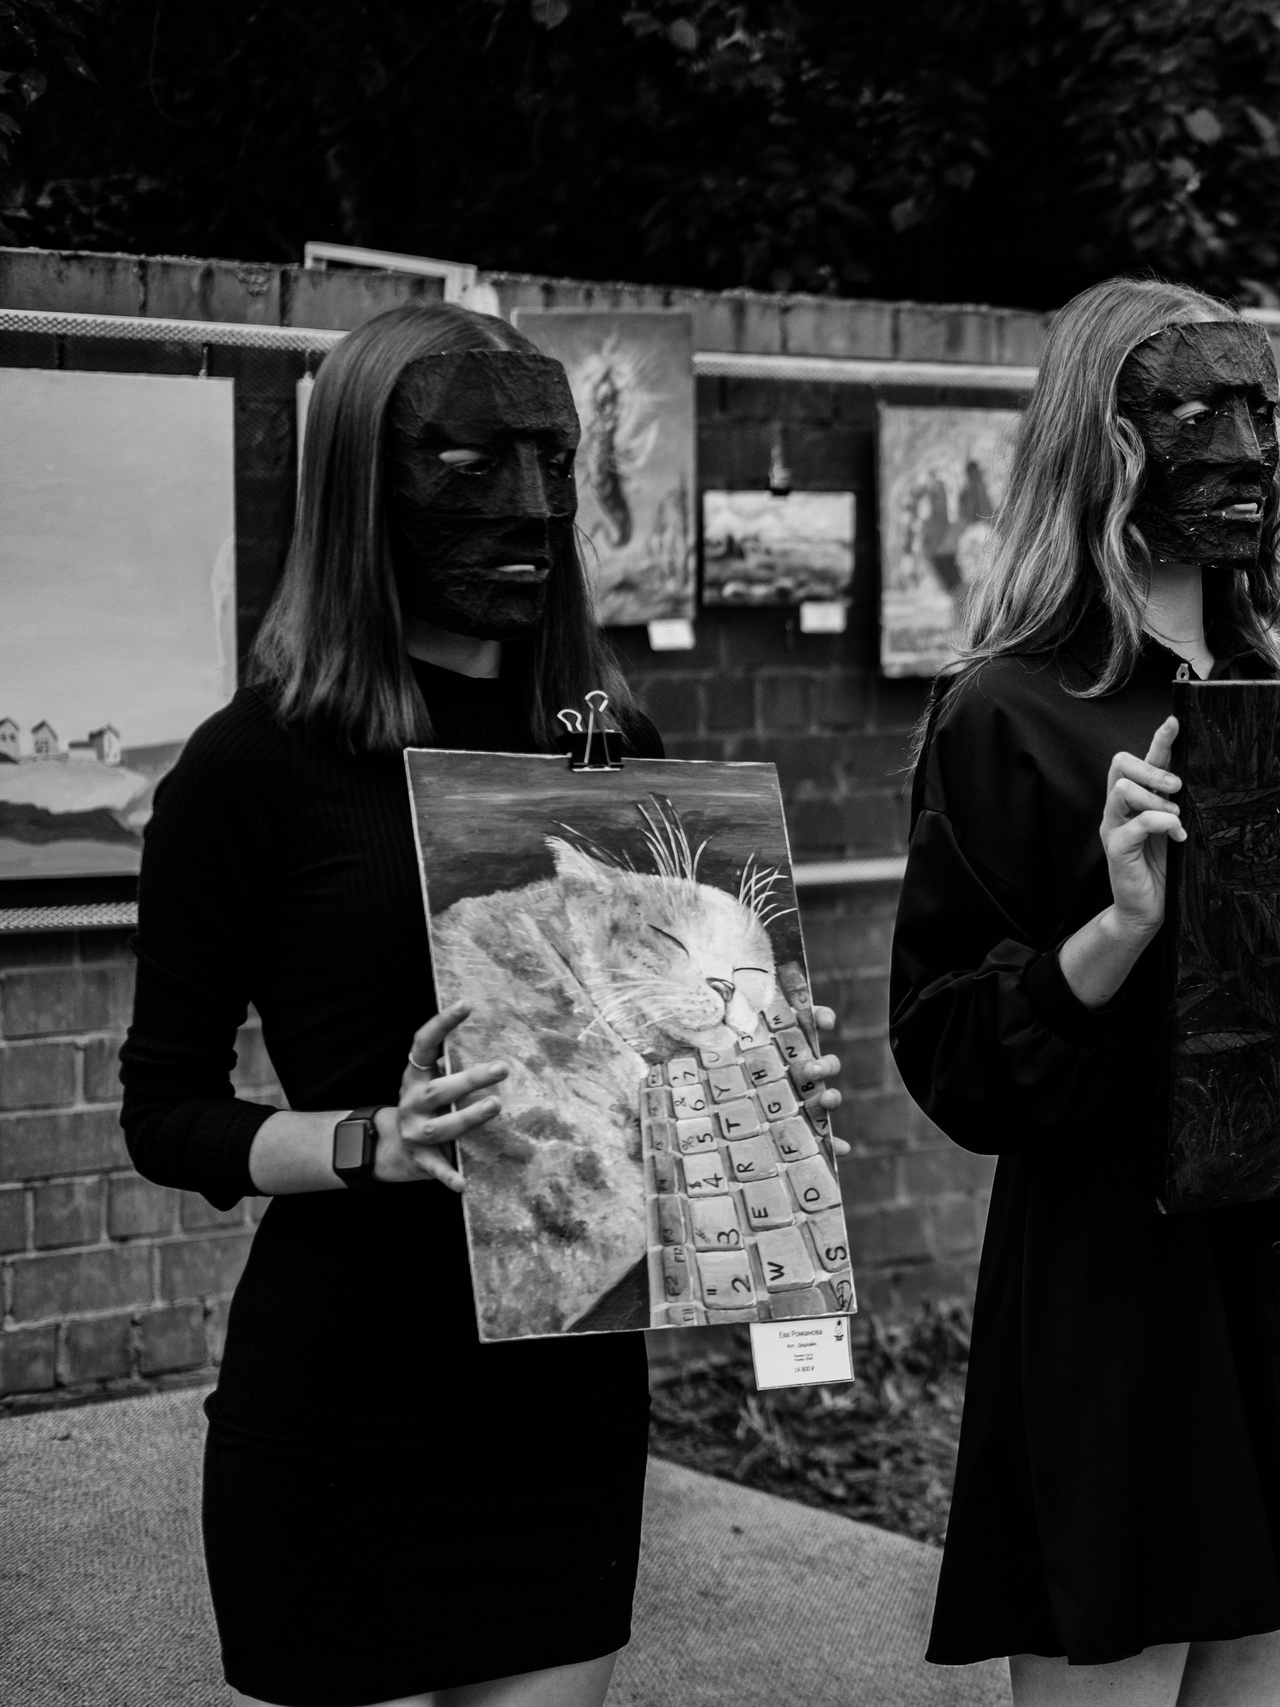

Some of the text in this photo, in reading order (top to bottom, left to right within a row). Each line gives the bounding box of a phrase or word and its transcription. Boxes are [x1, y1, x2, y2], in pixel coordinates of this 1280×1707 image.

[785, 1046, 798, 1059] N
[683, 1071, 696, 1081] 7
[751, 1069, 768, 1081] H
[714, 1085, 731, 1098] Y
[801, 1081, 815, 1093] B
[689, 1099, 706, 1112] 6
[767, 1101, 782, 1114] G
[725, 1117, 741, 1133] T
[696, 1132, 714, 1144] 5
[780, 1144, 798, 1155] F
[736, 1161, 755, 1173] R
[702, 1173, 724, 1189] 4
[803, 1187, 820, 1203] D
[751, 1206, 769, 1219] E
[717, 1228, 740, 1246] 3
[825, 1245, 847, 1261] S
[767, 1261, 785, 1282] W
[731, 1274, 752, 1293] 2
[778, 1329, 823, 1339] Ева Романова
